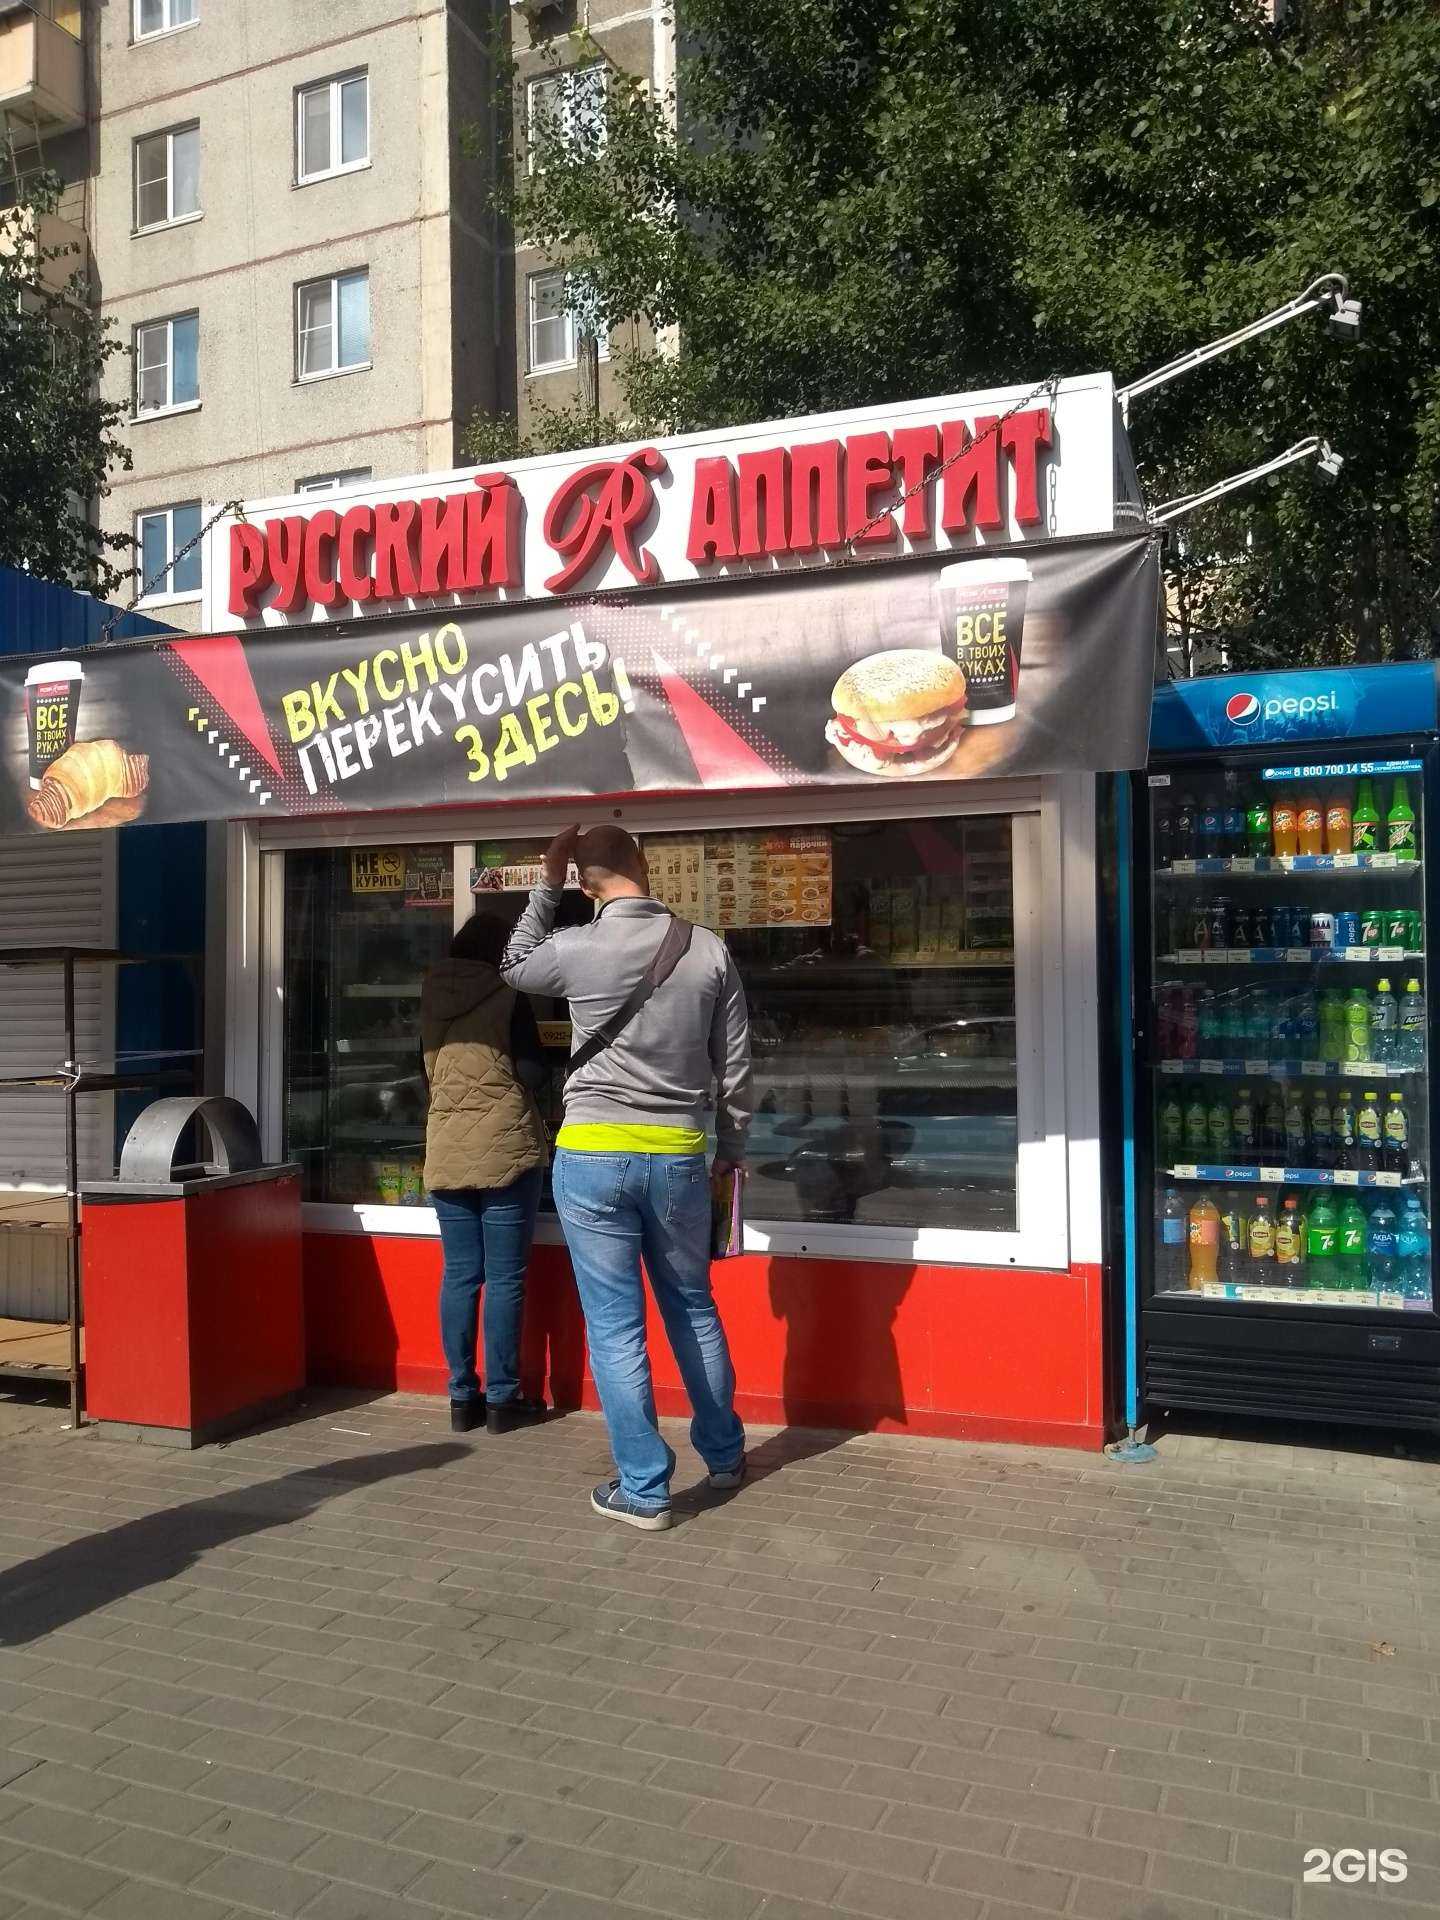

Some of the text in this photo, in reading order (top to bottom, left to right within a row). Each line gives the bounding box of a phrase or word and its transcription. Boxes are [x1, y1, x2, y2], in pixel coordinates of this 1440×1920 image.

[687, 407, 1055, 565] АППЕТИТ
[229, 472, 522, 619] РУССКИЙ
[956, 611, 1007, 646] ВСЕ
[957, 643, 1006, 660] В ТВОИХ
[281, 622, 469, 743] ВКУСНО
[36, 704, 69, 731] ВСЕ
[298, 621, 607, 795] ПЕРЕКУСИТЬ
[1265, 691, 1336, 720] pepsi
[455, 658, 634, 783] ЗДЕСЬ!
[36, 729, 66, 742] В ТВОИХ
[36, 739, 66, 754] РУКАХ
[1294, 767, 1301, 777] 8
[1303, 765, 1322, 776] 800
[1324, 765, 1345, 775] 700
[1346, 763, 1359, 774] 14
[1361, 763, 1374, 773] 55
[355, 853, 381, 874] НЕ
[355, 874, 401, 888] КУРИТЬ
